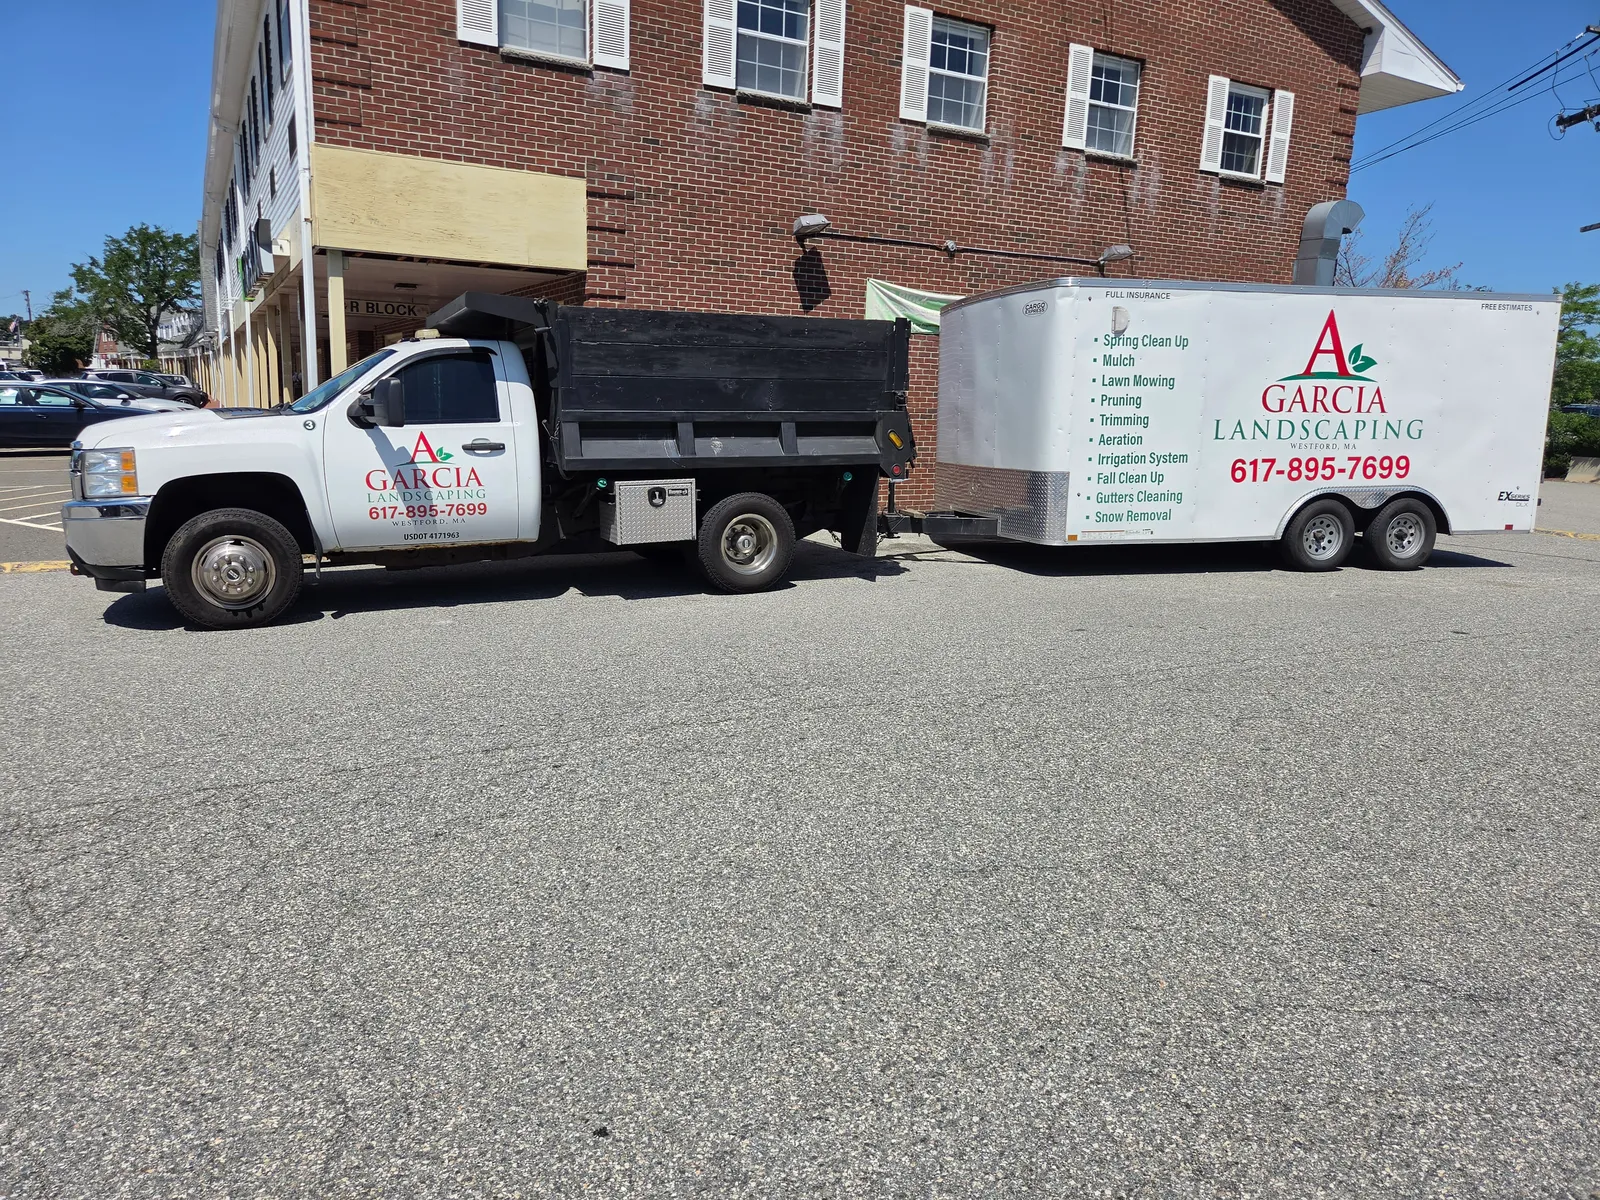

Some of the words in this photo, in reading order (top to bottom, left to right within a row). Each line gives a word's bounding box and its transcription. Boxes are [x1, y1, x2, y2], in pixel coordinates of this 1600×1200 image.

[1105, 291, 1125, 299] FULL
[1126, 292, 1171, 300] INSURANCE
[366, 302, 417, 316] BLOCK
[1025, 302, 1046, 310] CARGO
[1481, 303, 1497, 311] FREE
[1498, 304, 1533, 312] ESTIMATES
[1103, 334, 1139, 350] Spring
[1141, 335, 1172, 347] Clean
[1174, 336, 1189, 350] Up
[1298, 308, 1354, 377] A
[1102, 354, 1135, 367] Mulch
[1101, 375, 1130, 387] Lawn
[1133, 375, 1176, 390] Mowing
[1100, 394, 1142, 409] Pruning
[1261, 384, 1388, 414] GARCIA
[305, 420, 314, 430] 3
[1099, 414, 1150, 429] Trimming
[1213, 418, 1424, 441] LANDSCAPING
[409, 430, 441, 464] A
[1098, 433, 1143, 446] Aeration
[1290, 442, 1340, 451] WESTFORD,
[1097, 453, 1146, 468] Irrigation
[1149, 452, 1189, 467] System
[1230, 455, 1411, 483] 617-895-7699
[365, 466, 484, 492] GARCIA
[1097, 472, 1117, 485] Fall
[1118, 472, 1148, 484] Clean
[1150, 471, 1165, 486] Up
[367, 488, 487, 504] LANDSCAPING
[1096, 491, 1134, 504] Gutters
[1136, 490, 1183, 505] Cleaning
[368, 502, 488, 520] 617-895-7699
[1095, 511, 1124, 523] Snow
[1126, 509, 1172, 522] Removal
[403, 532, 428, 541] USDOT
[429, 531, 461, 540] 4171963
